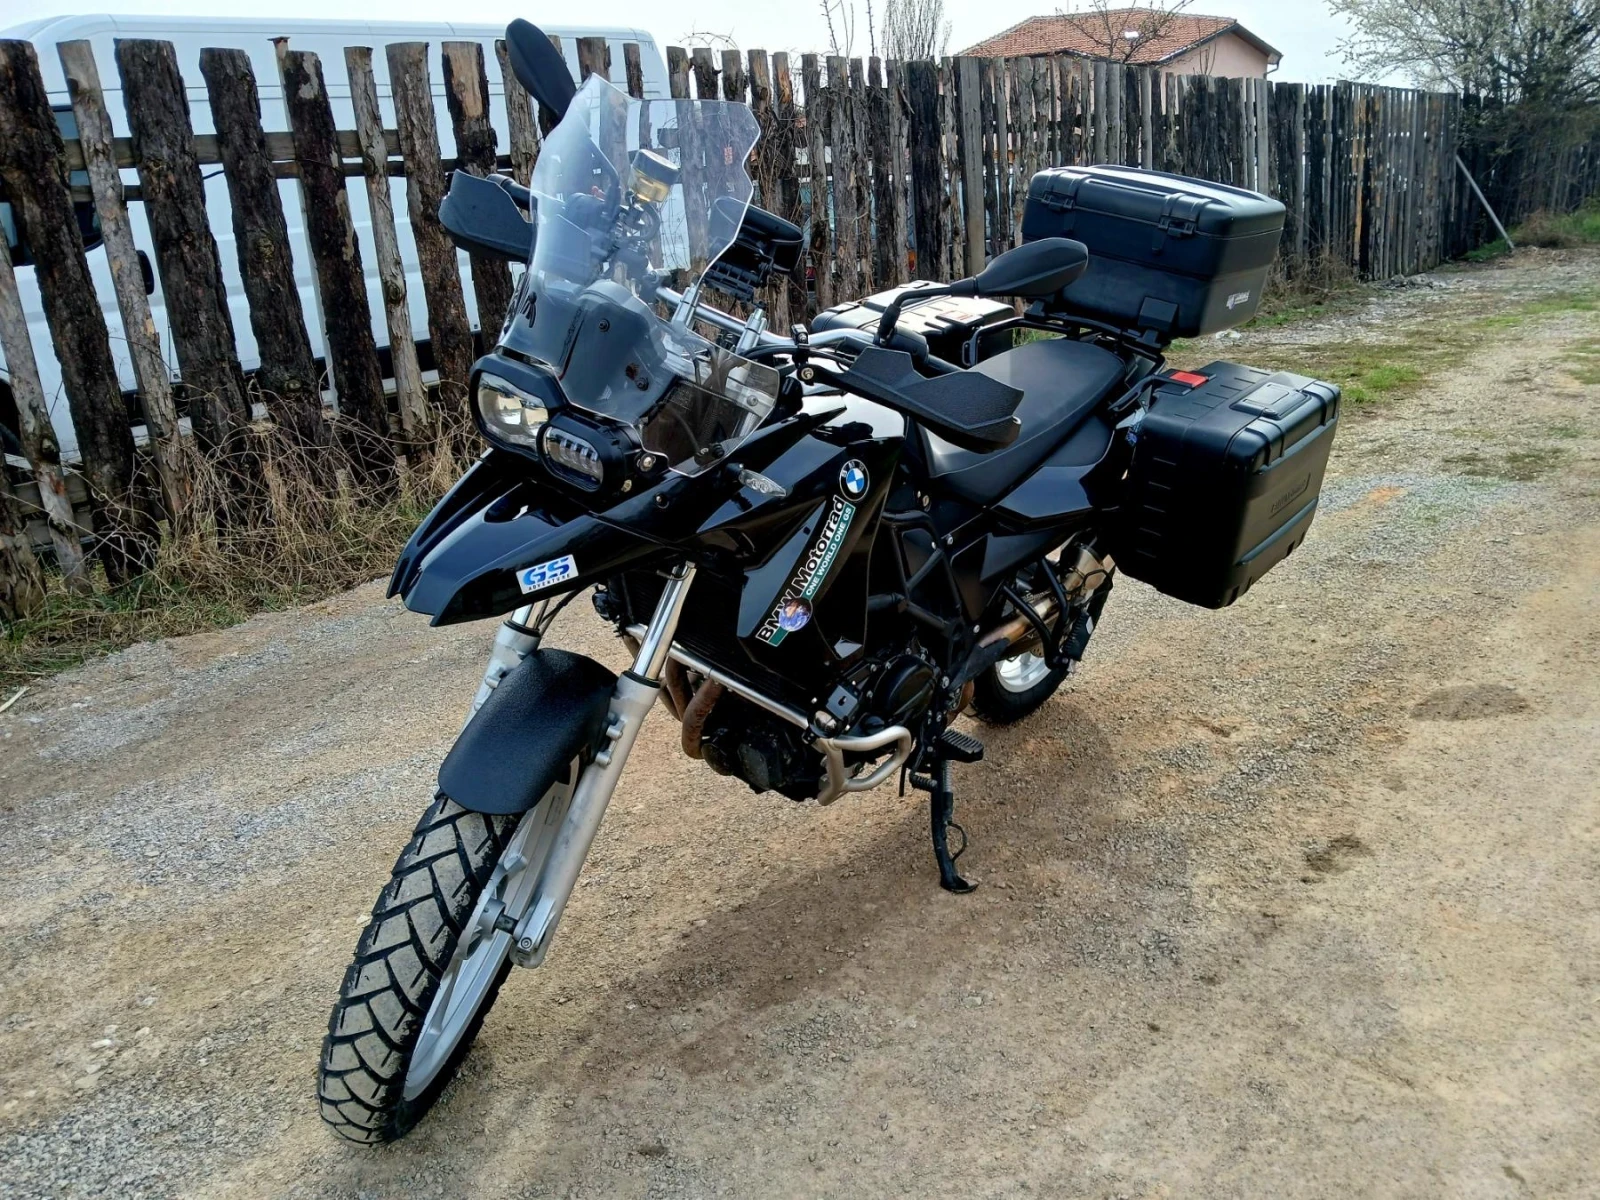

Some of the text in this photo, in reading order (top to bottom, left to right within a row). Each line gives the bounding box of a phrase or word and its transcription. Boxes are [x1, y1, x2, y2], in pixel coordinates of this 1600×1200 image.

[523, 557, 570, 586] GS
[791, 494, 846, 591] Motorrad
[805, 507, 852, 596] ONE WORLD ONE GS
[528, 573, 570, 591] ADVENTURE
